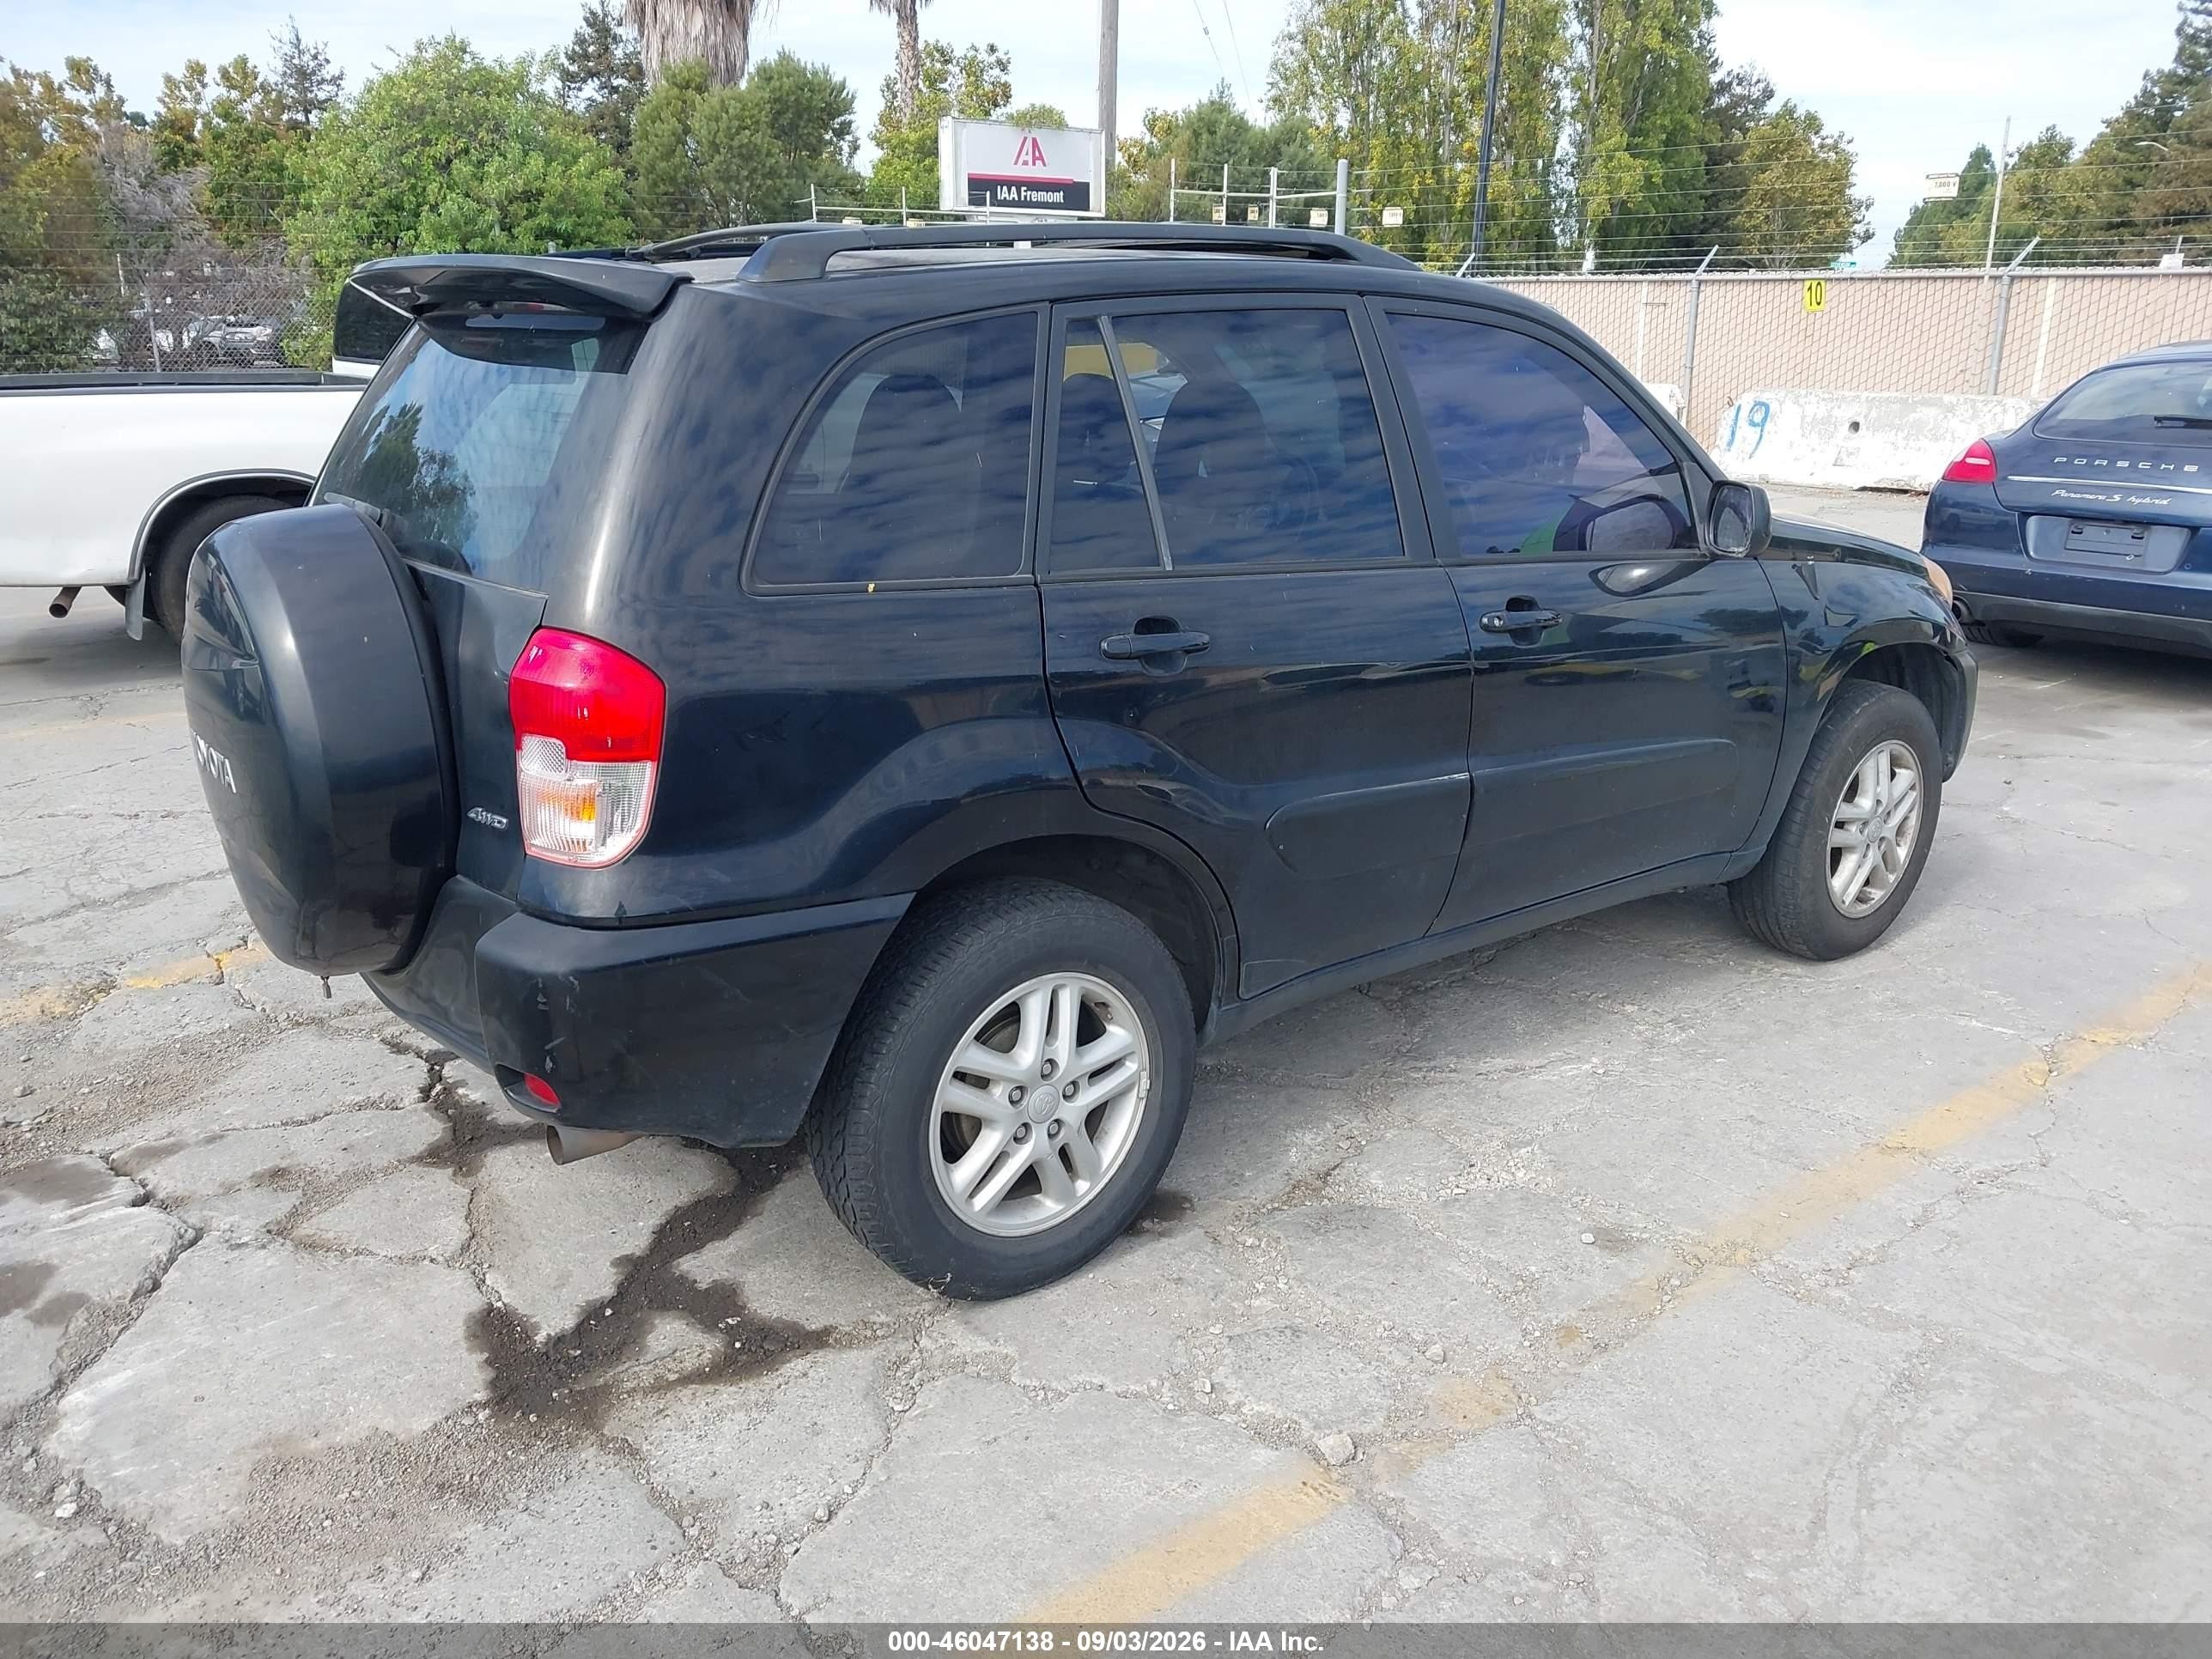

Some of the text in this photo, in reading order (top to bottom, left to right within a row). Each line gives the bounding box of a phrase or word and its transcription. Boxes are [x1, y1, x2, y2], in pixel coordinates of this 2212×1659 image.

[997, 185, 1065, 204] IAA Fremont
[1807, 281, 1823, 307] 10
[1726, 400, 1771, 459] 19
[2053, 457, 2199, 472] PORSCHE
[2051, 489, 2172, 506] Panamera S hybrid
[191, 728, 237, 794] OYOTA
